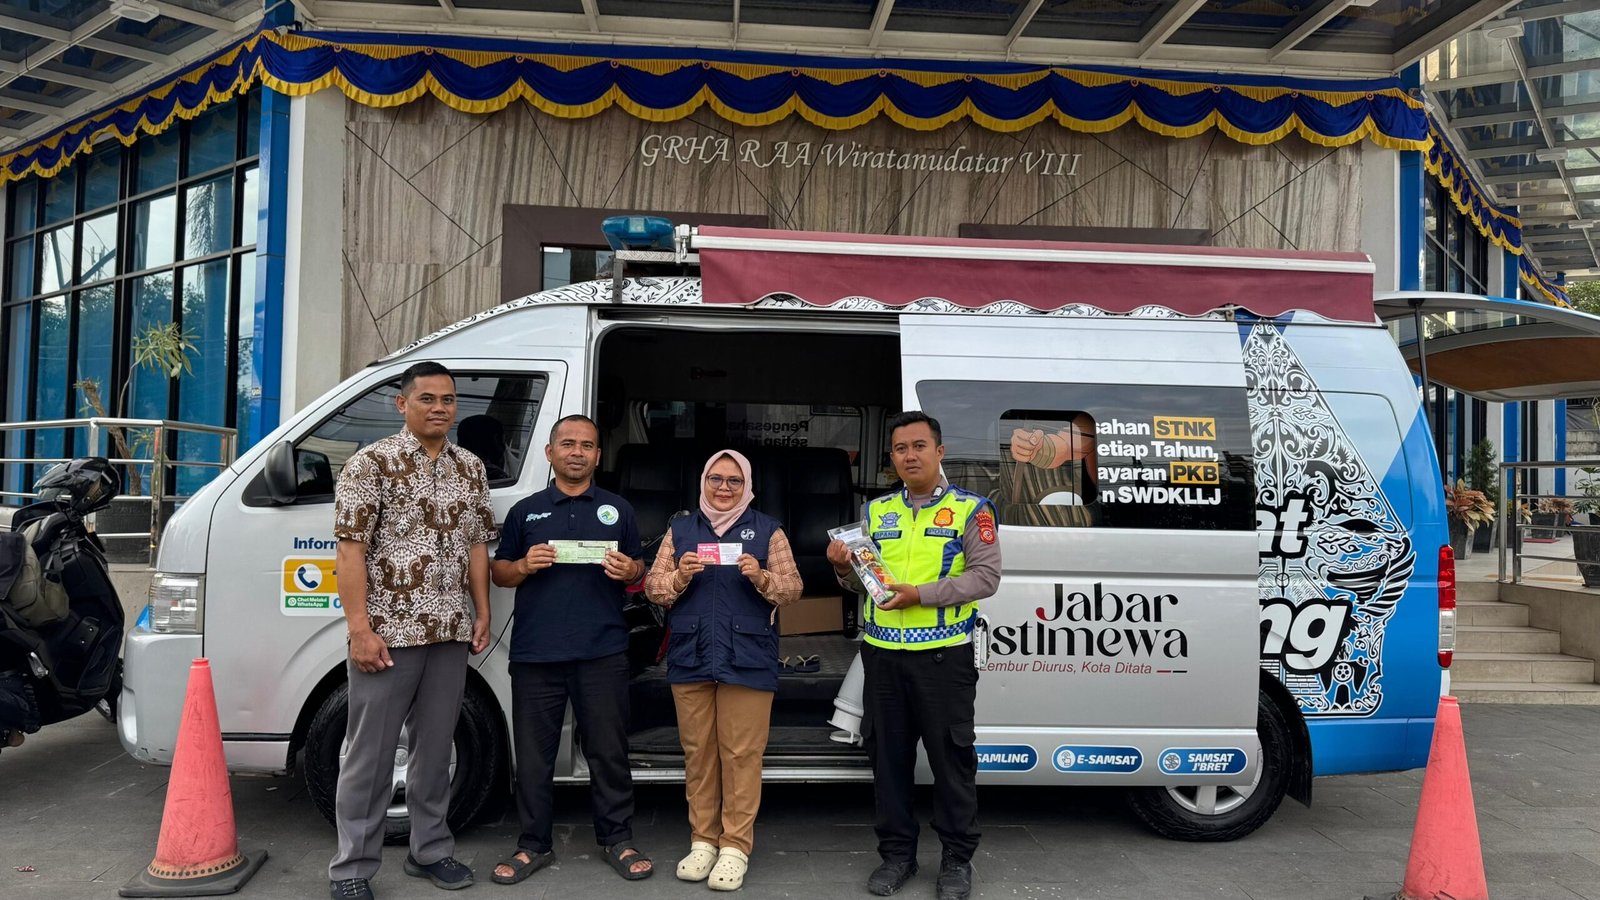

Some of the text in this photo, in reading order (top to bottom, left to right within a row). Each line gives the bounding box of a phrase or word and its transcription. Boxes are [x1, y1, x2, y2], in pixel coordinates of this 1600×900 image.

[640, 134, 731, 166] GRHA
[820, 142, 1013, 174] Wiratanudatar
[1018, 152, 1083, 176] VIII
[1156, 420, 1214, 437] STNK
[1097, 440, 1219, 462] etiap Tahun,
[1098, 465, 1217, 483] ayaran PKB
[1118, 487, 1221, 505] SWDKLLJ
[1035, 582, 1179, 623] Jabar
[1032, 660, 1076, 674] Diurus,
[1081, 661, 1111, 674] Kota
[1114, 661, 1152, 674] Ditata
[977, 753, 1029, 764] SAMLING
[1076, 754, 1138, 766] E-SAMSAT
[1187, 753, 1235, 763] SAMSAT
[1192, 762, 1229, 772] J'BRET
